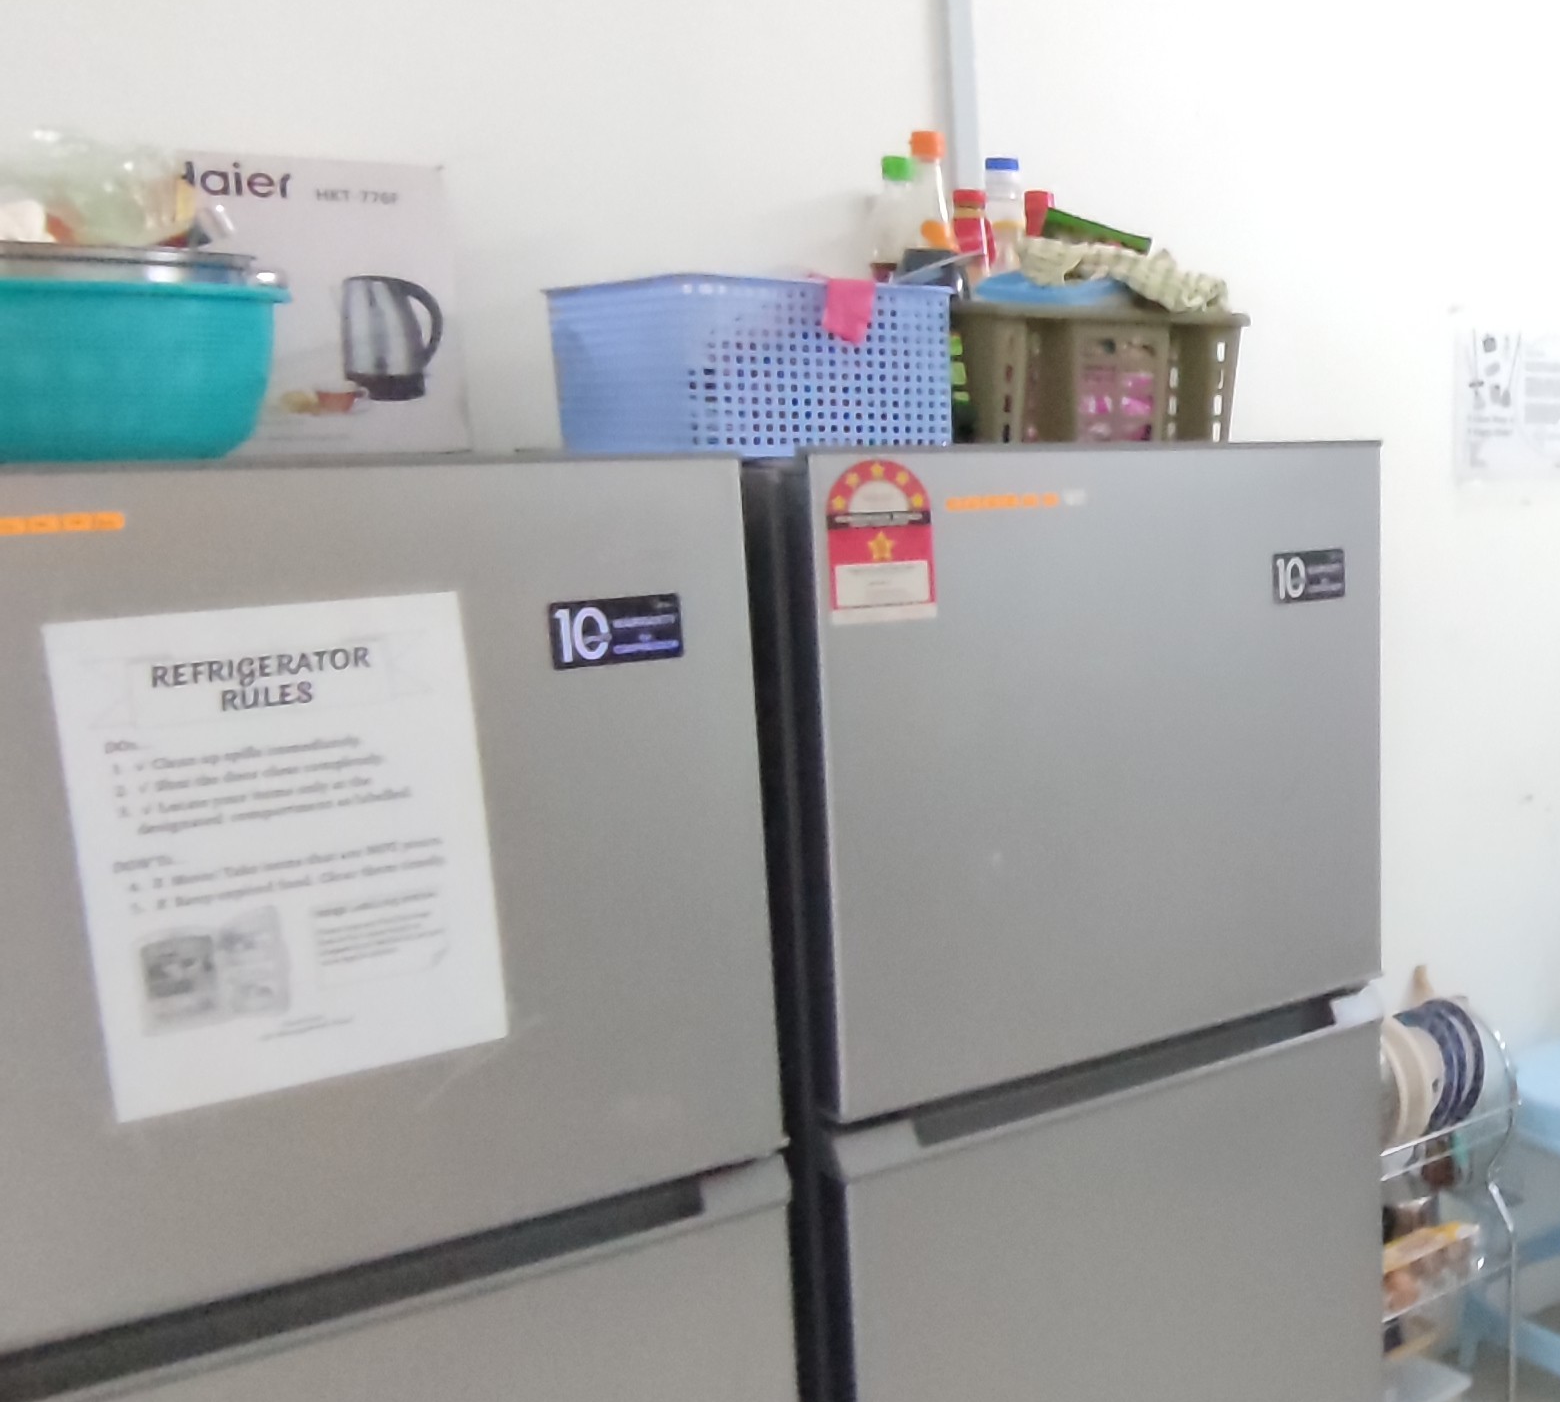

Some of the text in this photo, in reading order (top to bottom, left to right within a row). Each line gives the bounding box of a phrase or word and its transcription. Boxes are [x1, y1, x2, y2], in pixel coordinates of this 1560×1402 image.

[1276, 557, 1306, 600] 10
[554, 606, 611, 664] 10
[151, 646, 371, 688] REFRIGERATOR
[220, 681, 314, 711] RULES
